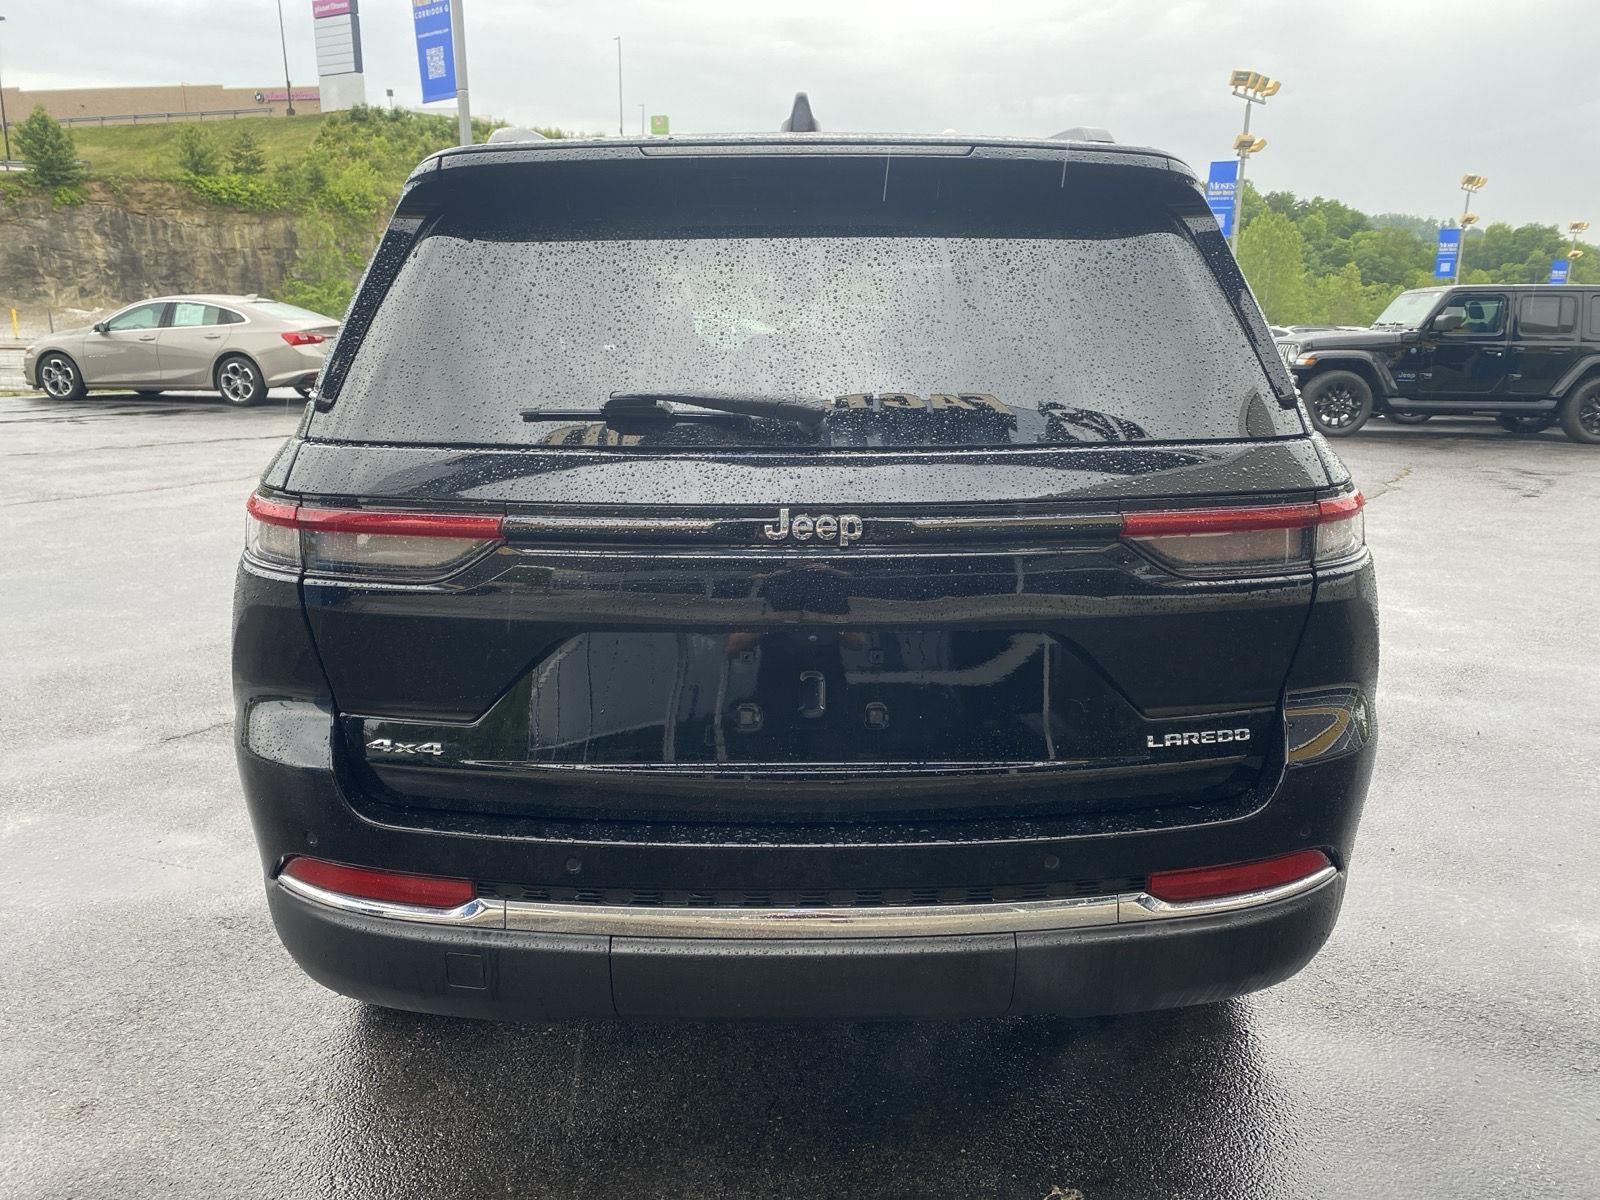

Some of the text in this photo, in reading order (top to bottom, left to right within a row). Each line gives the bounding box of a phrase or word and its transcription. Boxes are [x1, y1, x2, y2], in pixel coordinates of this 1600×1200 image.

[415, 6, 443, 19] CORRIDOR
[764, 508, 863, 547] Jeep
[366, 739, 445, 755] 4x4
[1147, 728, 1251, 748] LAREDO
